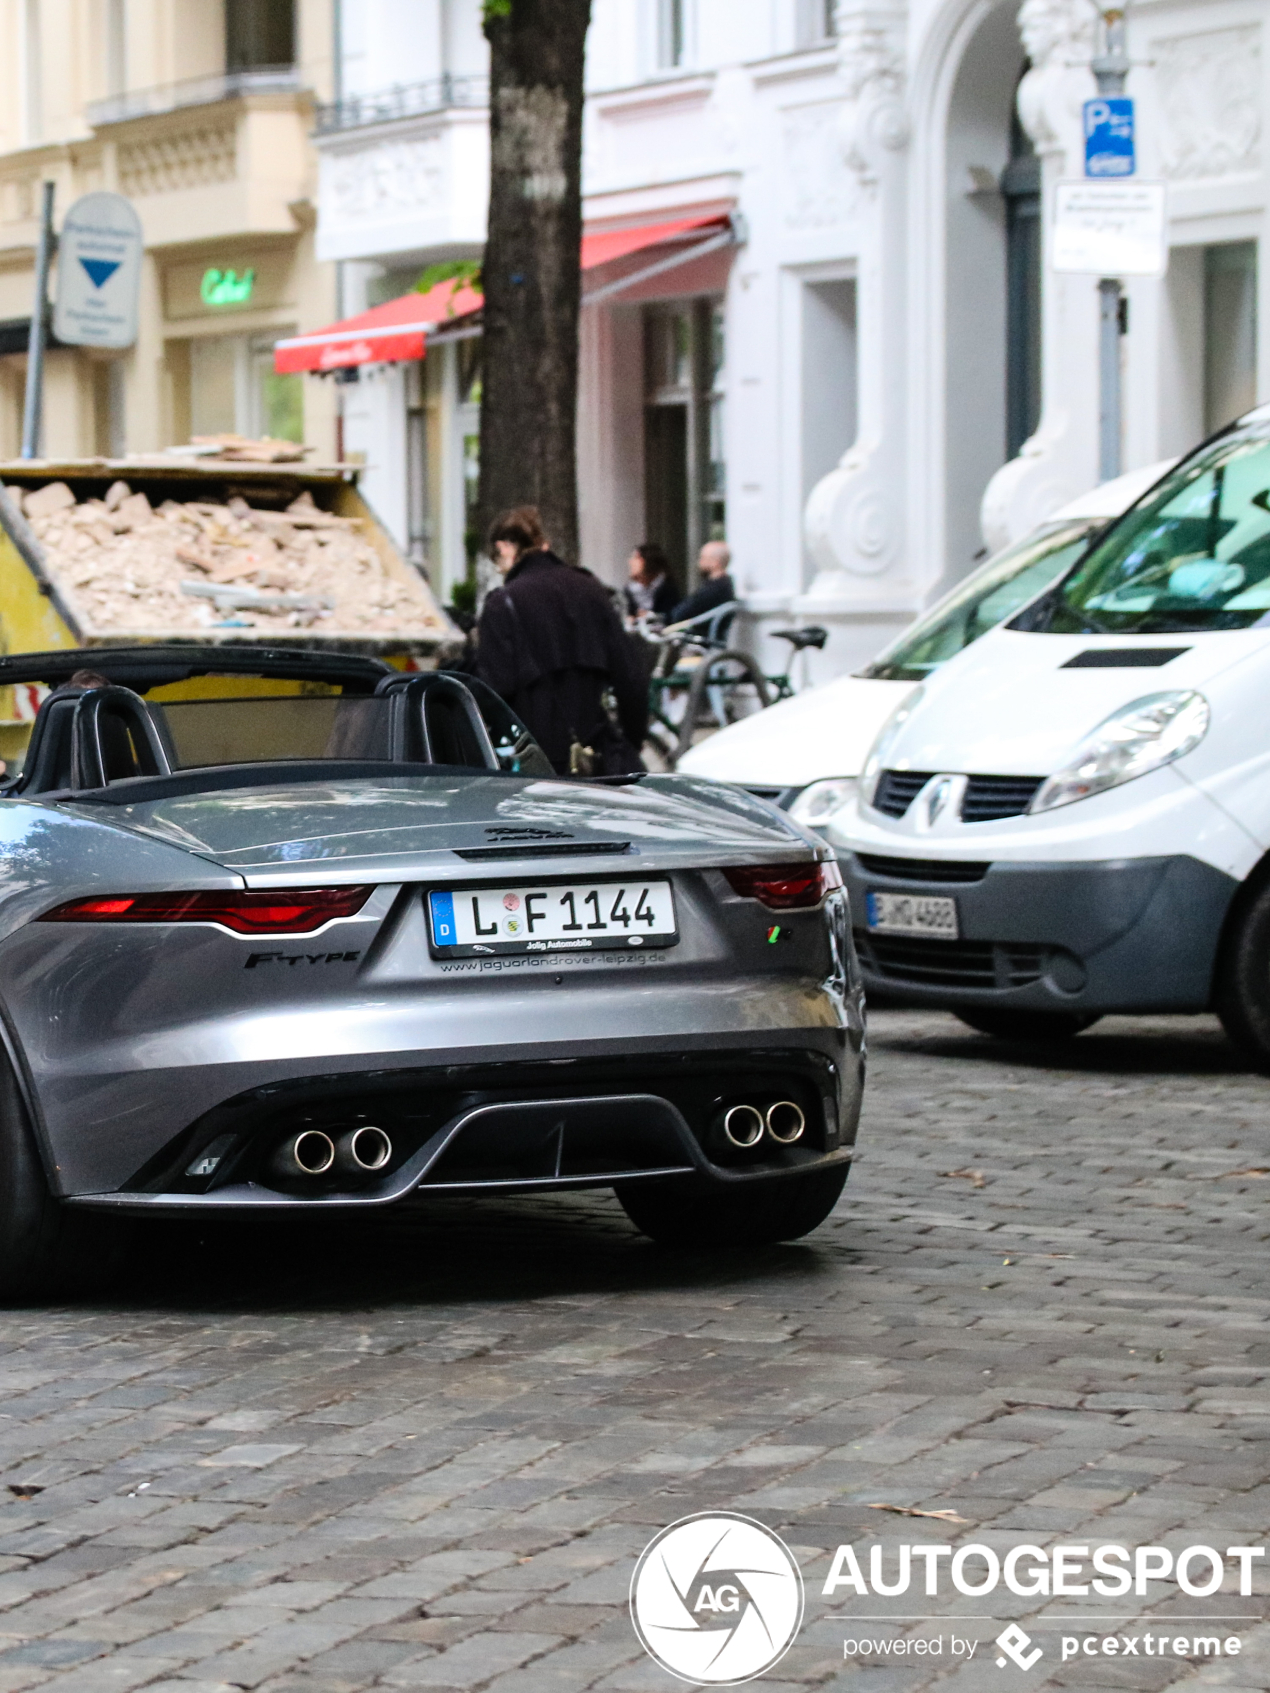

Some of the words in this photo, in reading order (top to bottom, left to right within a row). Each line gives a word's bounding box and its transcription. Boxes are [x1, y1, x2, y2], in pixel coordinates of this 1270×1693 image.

[1086, 102, 1111, 138] P
[472, 896, 498, 936] L
[525, 892, 548, 933] F
[560, 888, 655, 931] 1144
[440, 924, 450, 936] D
[547, 939, 592, 949] Automobile
[441, 952, 667, 972] www.jaguarlandrover-leipzig.de
